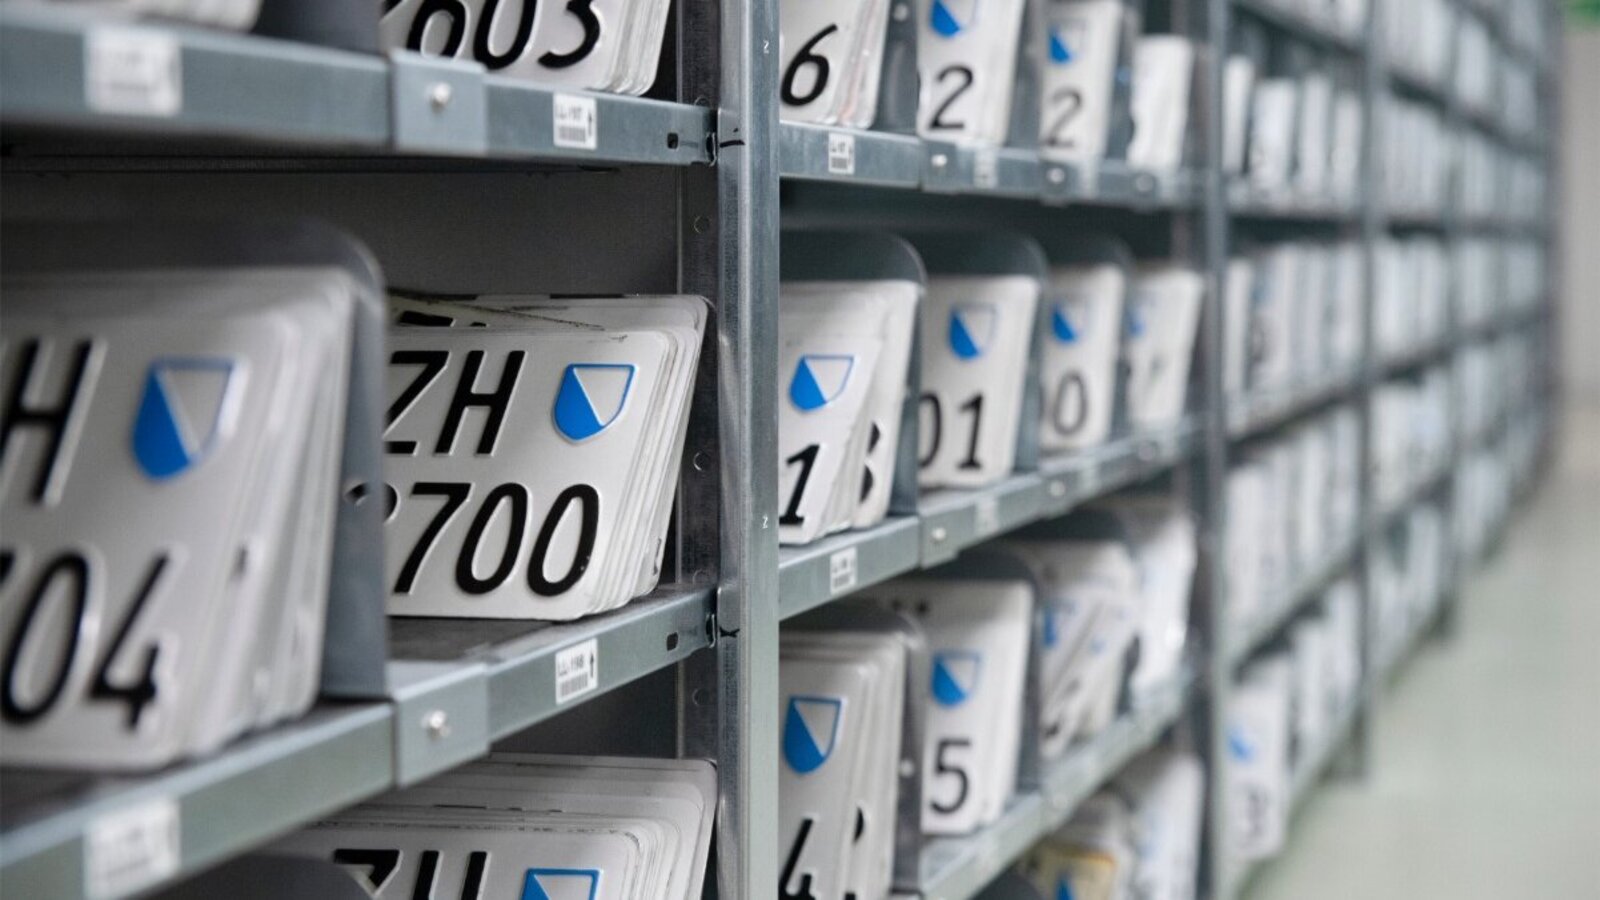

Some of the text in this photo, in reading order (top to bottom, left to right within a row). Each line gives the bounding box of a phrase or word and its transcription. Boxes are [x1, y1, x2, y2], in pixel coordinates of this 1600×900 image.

[780, 23, 838, 107] 6
[928, 65, 974, 131] 2
[386, 350, 526, 456] ZH
[779, 444, 821, 526] 1
[0, 548, 170, 730] 04
[930, 738, 970, 814] 5
[779, 818, 816, 900] 4
